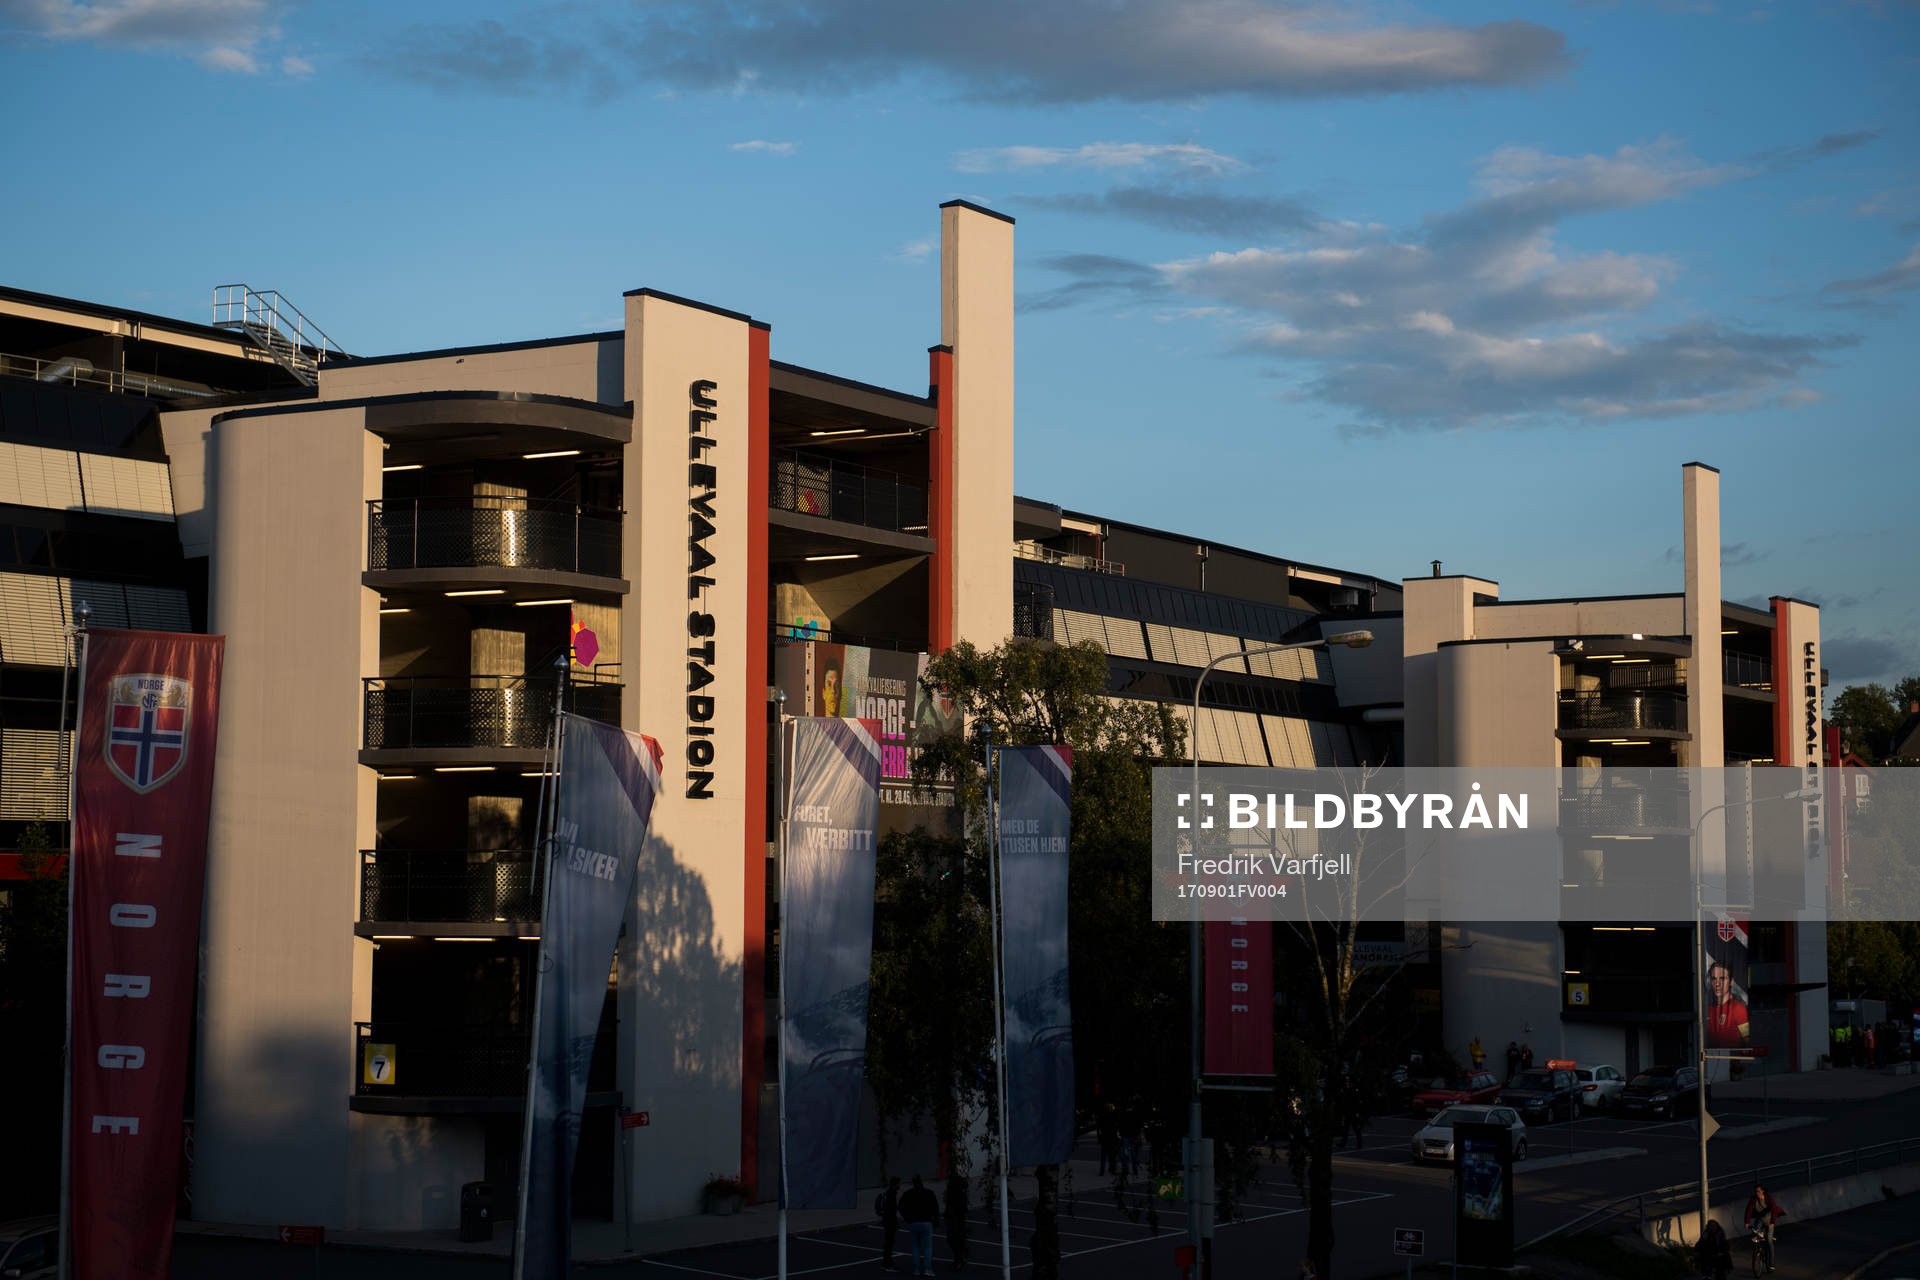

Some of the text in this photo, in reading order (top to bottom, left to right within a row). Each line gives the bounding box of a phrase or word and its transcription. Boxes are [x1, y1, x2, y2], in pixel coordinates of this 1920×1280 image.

[686, 379, 717, 799] ULLEVAAL STADION
[138, 679, 165, 691] NORGE
[1026, 820, 1039, 834] DE
[1002, 837, 1066, 853] TUSEN HJEM
[567, 845, 619, 880] LSKER
[92, 833, 163, 1135] NORGE
[1576, 991, 1582, 1002] 5
[375, 1061, 385, 1079] 7
